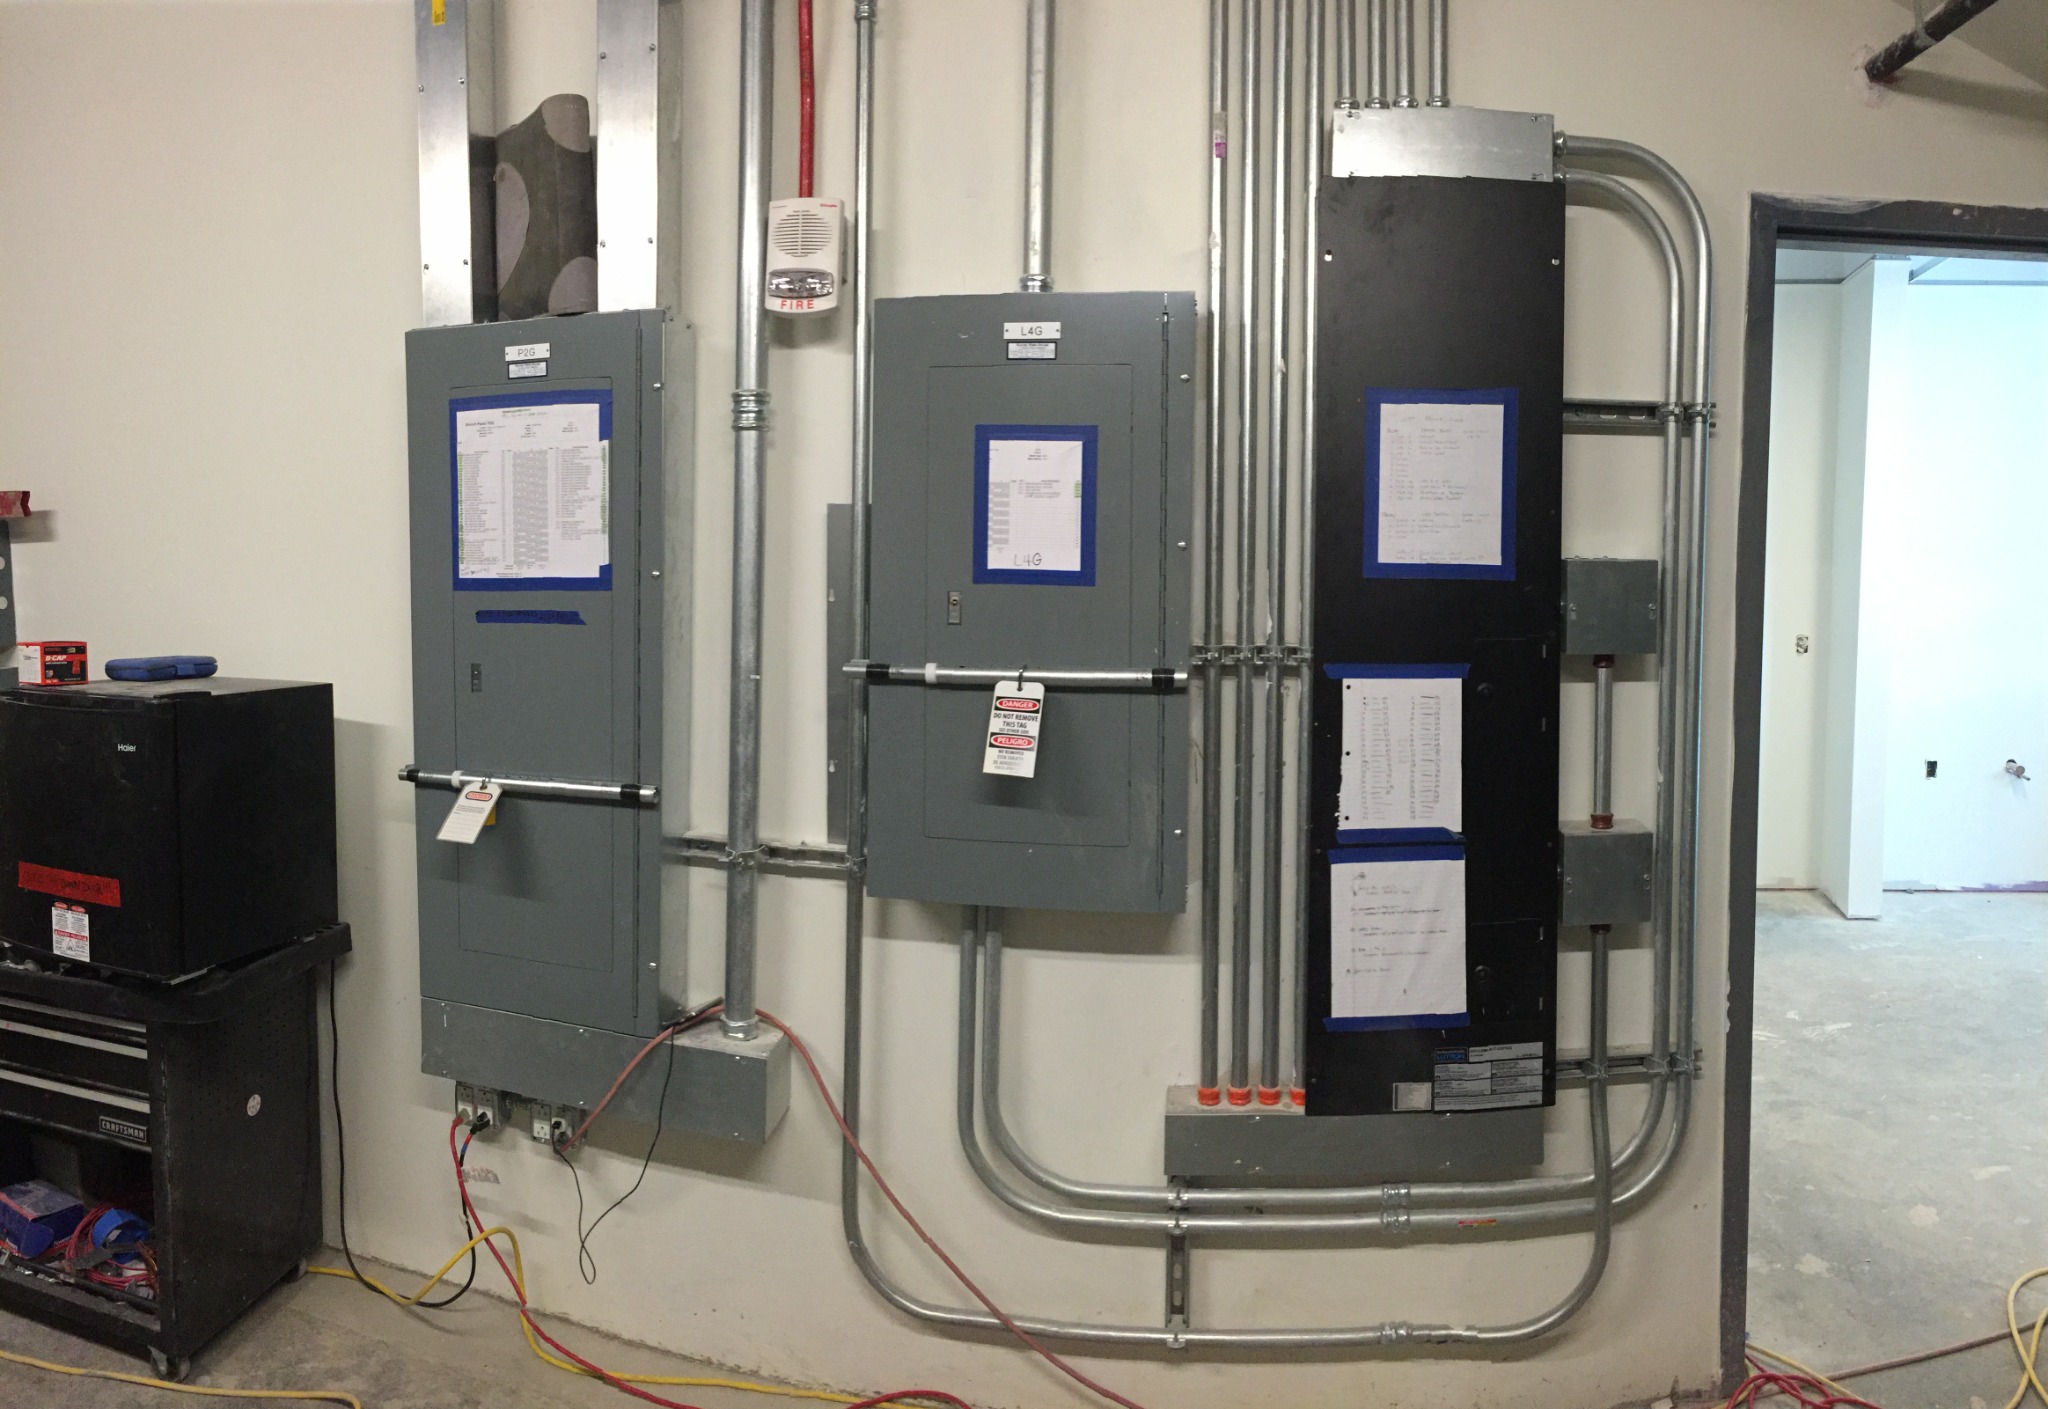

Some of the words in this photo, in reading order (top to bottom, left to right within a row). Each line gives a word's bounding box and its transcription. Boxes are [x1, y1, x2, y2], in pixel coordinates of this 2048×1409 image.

[781, 299, 814, 309] FIRE
[1021, 326, 1043, 336] L4G
[518, 348, 535, 357] P2G
[1014, 553, 1042, 567] L4G
[1015, 714, 1039, 722] REMOVE
[998, 737, 1028, 745] PELIGRO
[118, 744, 136, 752] Haier
[102, 1121, 144, 1139] CRAFTSMAN
